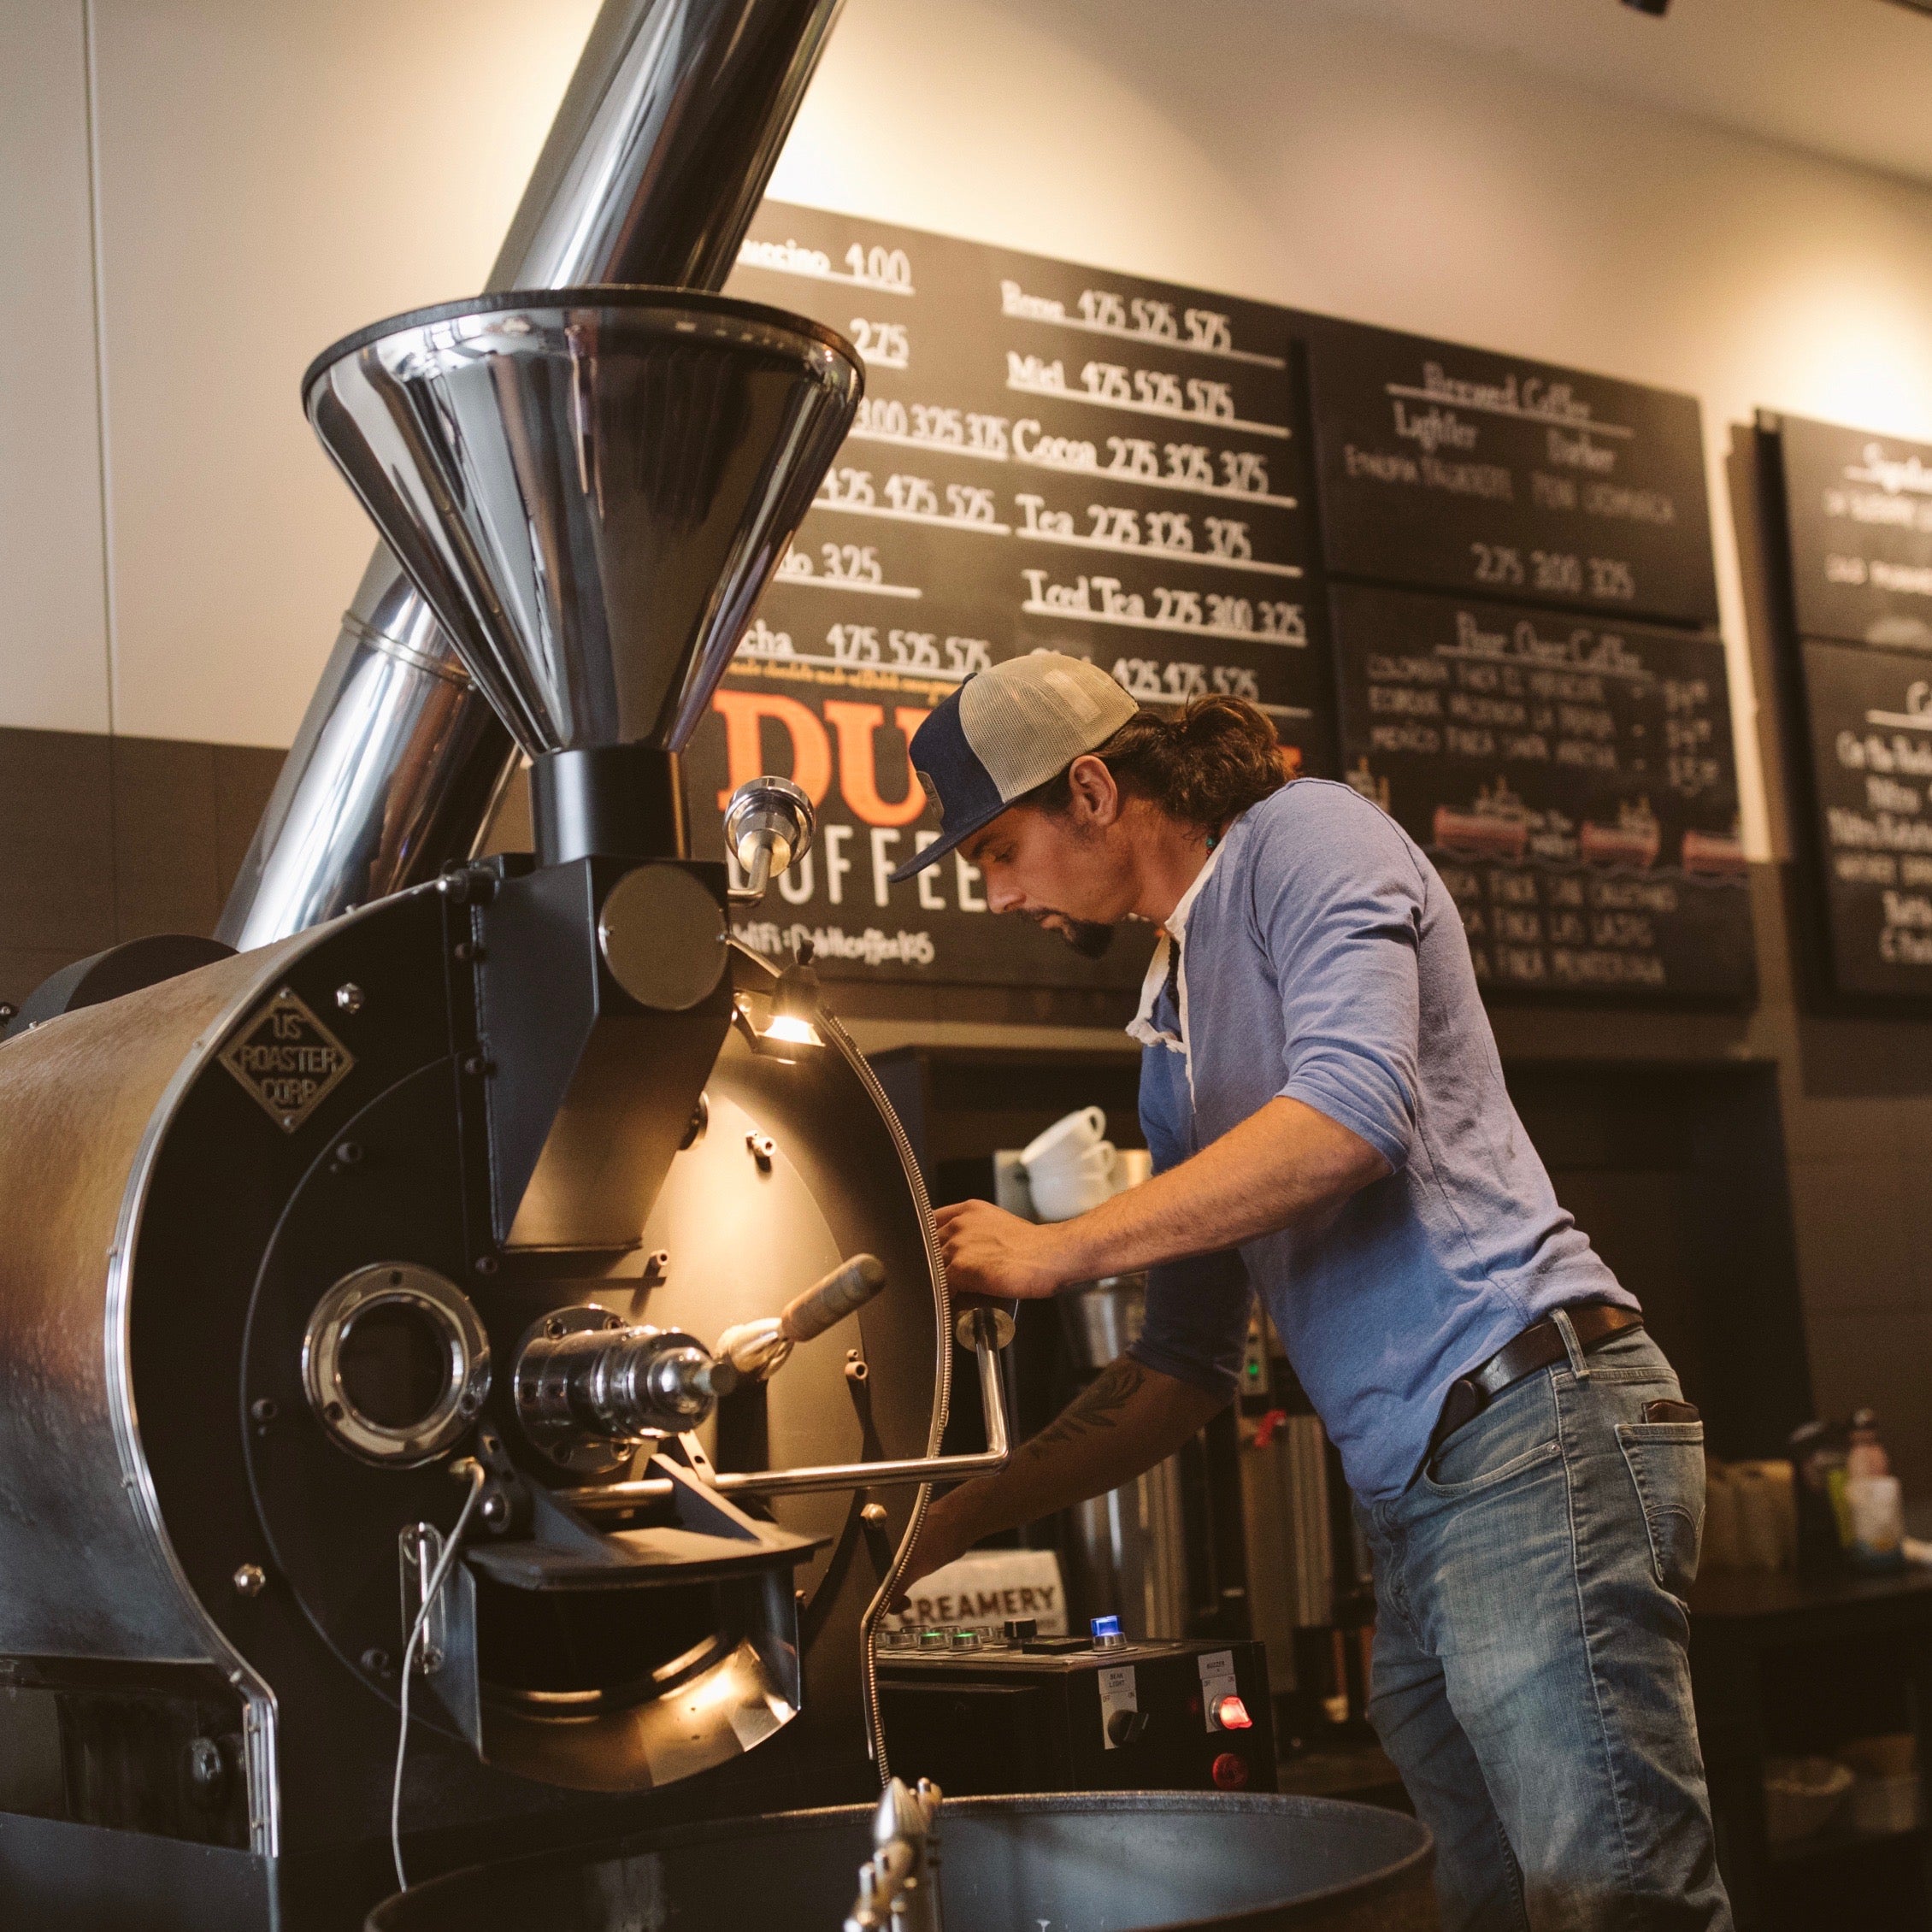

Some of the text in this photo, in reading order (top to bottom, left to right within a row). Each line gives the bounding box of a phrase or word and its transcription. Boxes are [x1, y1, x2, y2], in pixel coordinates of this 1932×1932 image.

[740, 239, 831, 272] uccino
[849, 317, 910, 366] 275
[1078, 289, 1126, 330] 475
[1131, 297, 1178, 339] 525
[1184, 308, 1231, 351] 575
[1081, 361, 1131, 402] 475
[1134, 369, 1183, 411] 525
[1187, 377, 1235, 421] 575
[1107, 436, 1158, 479] 275
[884, 474, 939, 514] 475
[945, 483, 995, 522] 525
[1014, 493, 1075, 536] Tea
[1087, 504, 1140, 547] 275
[822, 542, 882, 585] 325
[1091, 577, 1146, 617] Tea
[1153, 586, 1203, 627] 275
[826, 623, 881, 663] 475
[888, 628, 940, 670] 525
[727, 824, 987, 913] OFFEE
[272, 1015, 303, 1040] US
[242, 1046, 337, 1074] ROASTER
[262, 1078, 318, 1104] CORP
